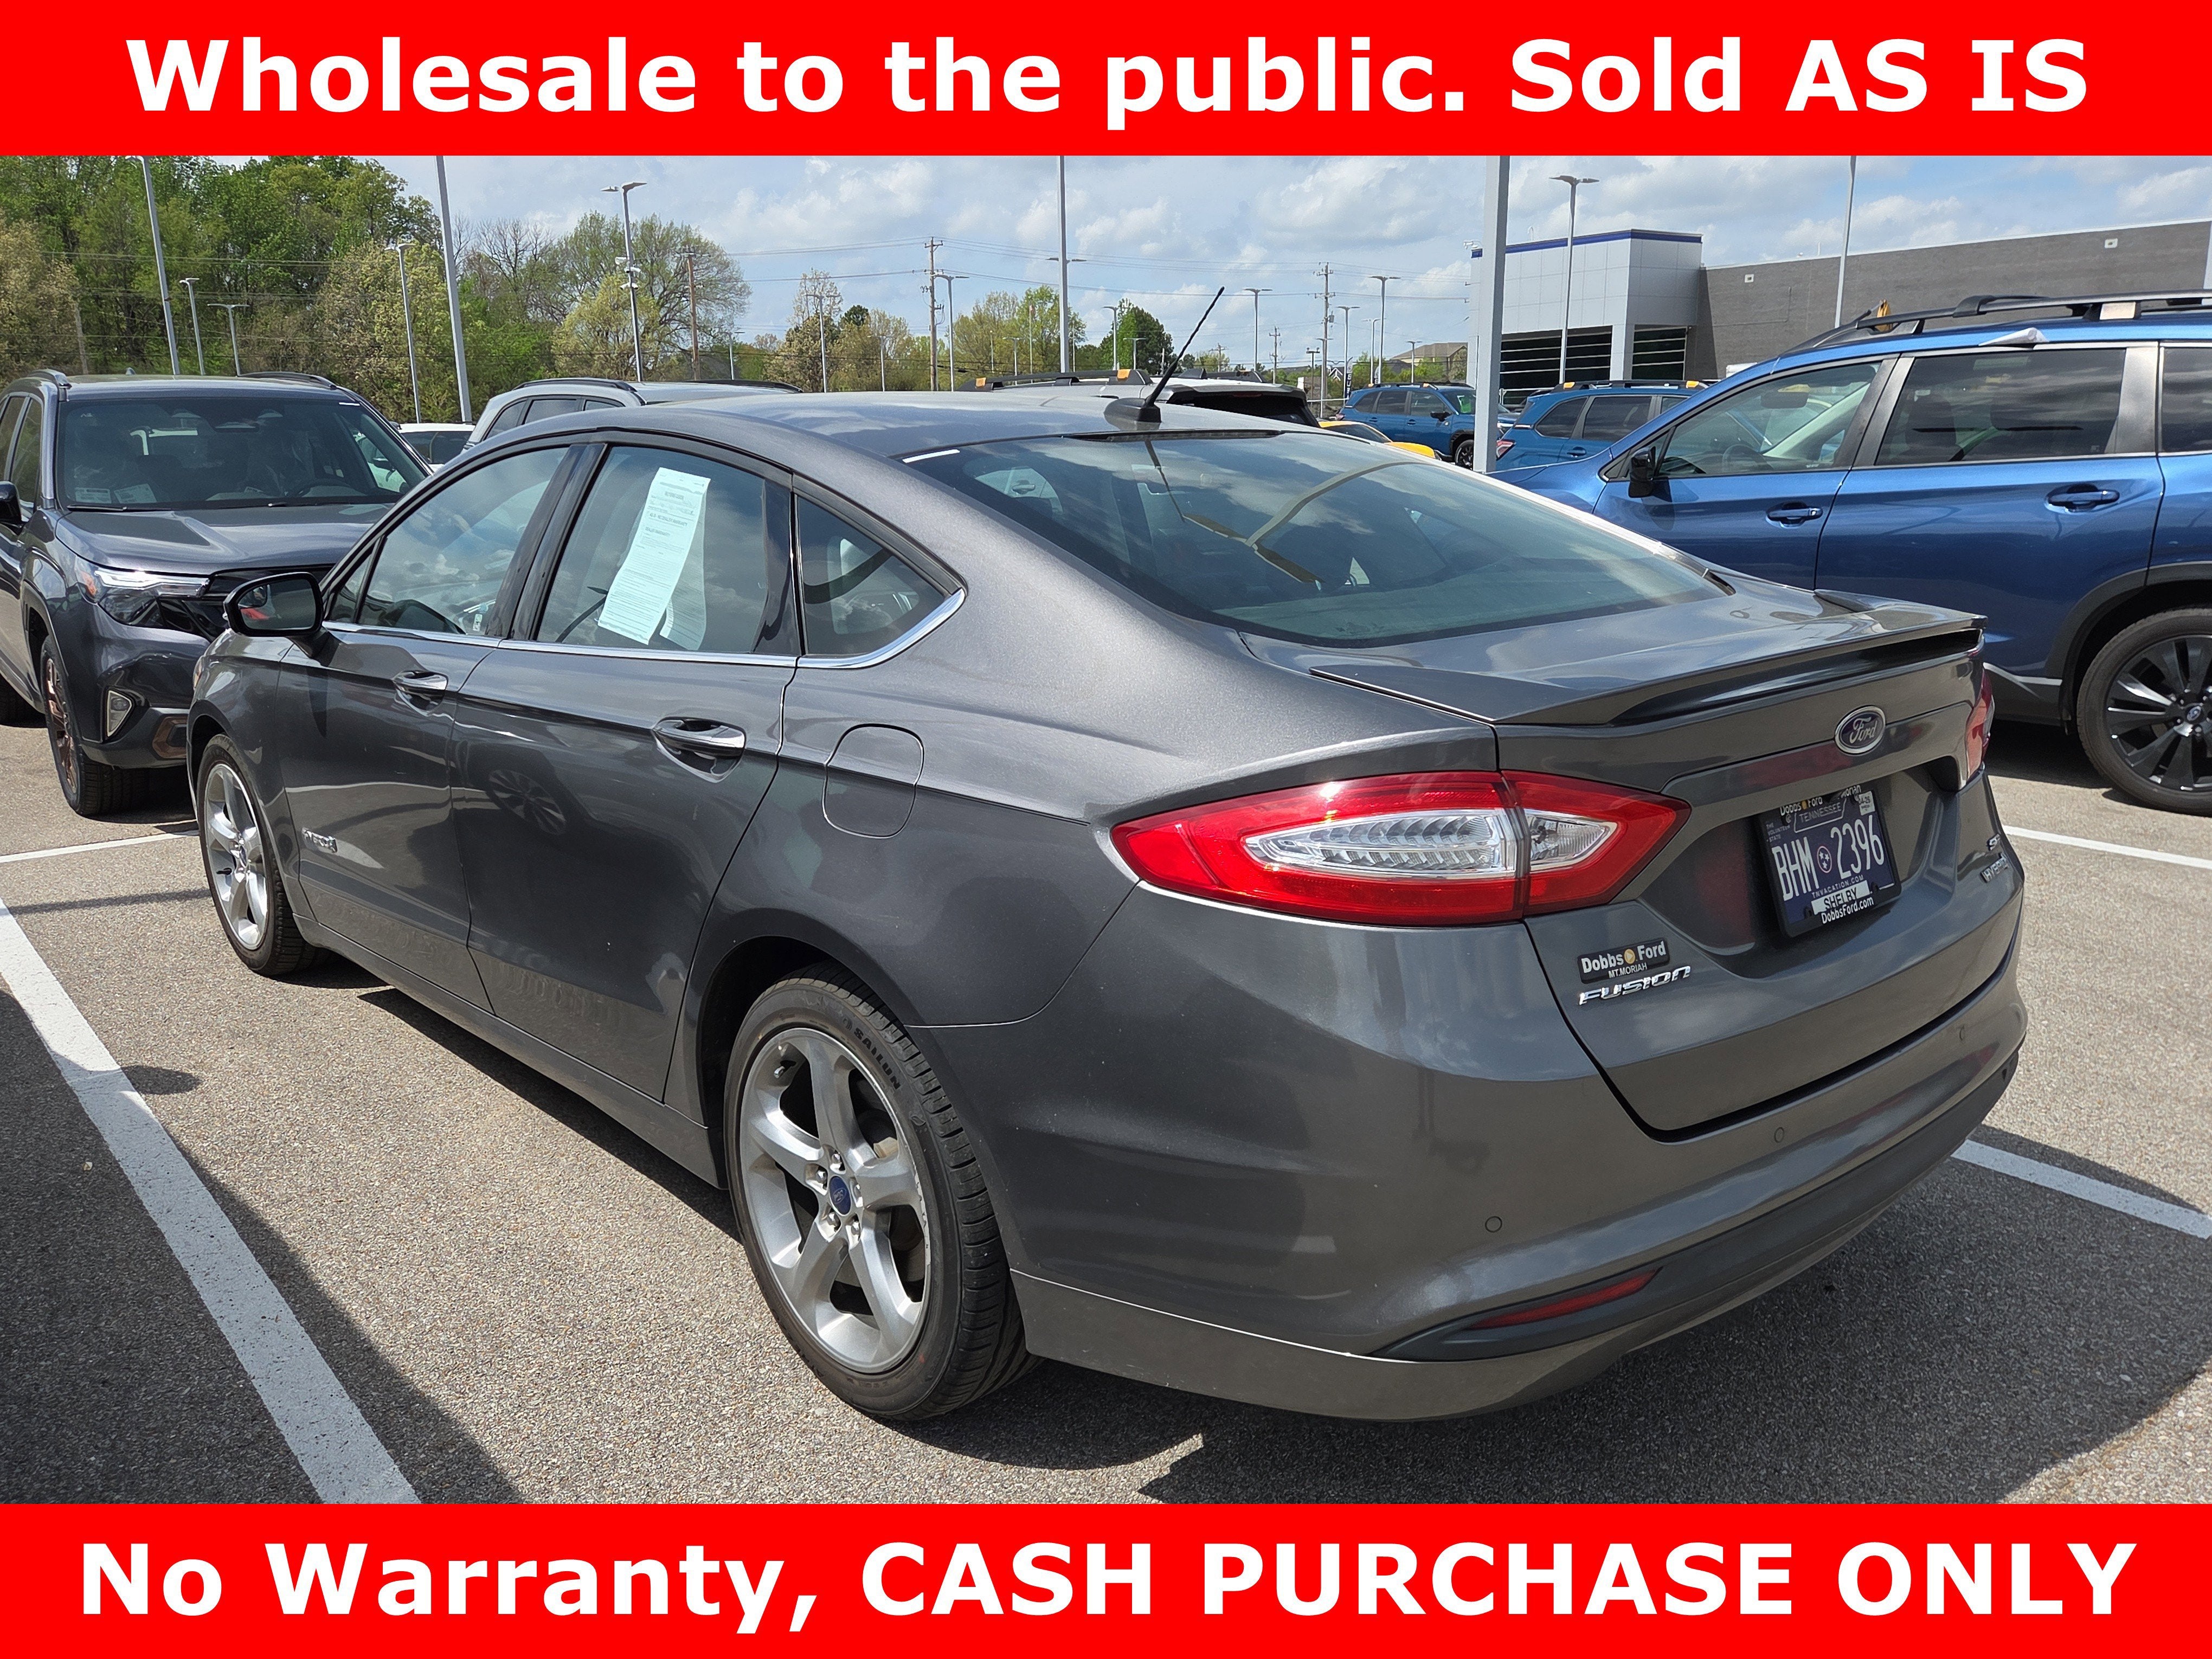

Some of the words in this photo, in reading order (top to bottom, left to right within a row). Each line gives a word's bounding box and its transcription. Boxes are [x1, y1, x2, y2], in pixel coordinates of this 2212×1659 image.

[1849, 717, 1877, 743] Ford
[1799, 802, 1842, 823] TENNESSEE
[1771, 837, 1819, 902] BHM
[1830, 815, 1885, 879] 2396
[1811, 874, 1864, 899] TNVACATION.COM
[1823, 886, 1858, 910] SHELBY
[1821, 896, 1875, 924] DobbsFord.com
[1581, 953, 1624, 974] Dobbs
[1637, 940, 1667, 961] Ford
[1608, 962, 1648, 979] MT.MORIAH
[1579, 966, 1691, 1005] FUSION
[853, 1027, 901, 1090] SAILUN
